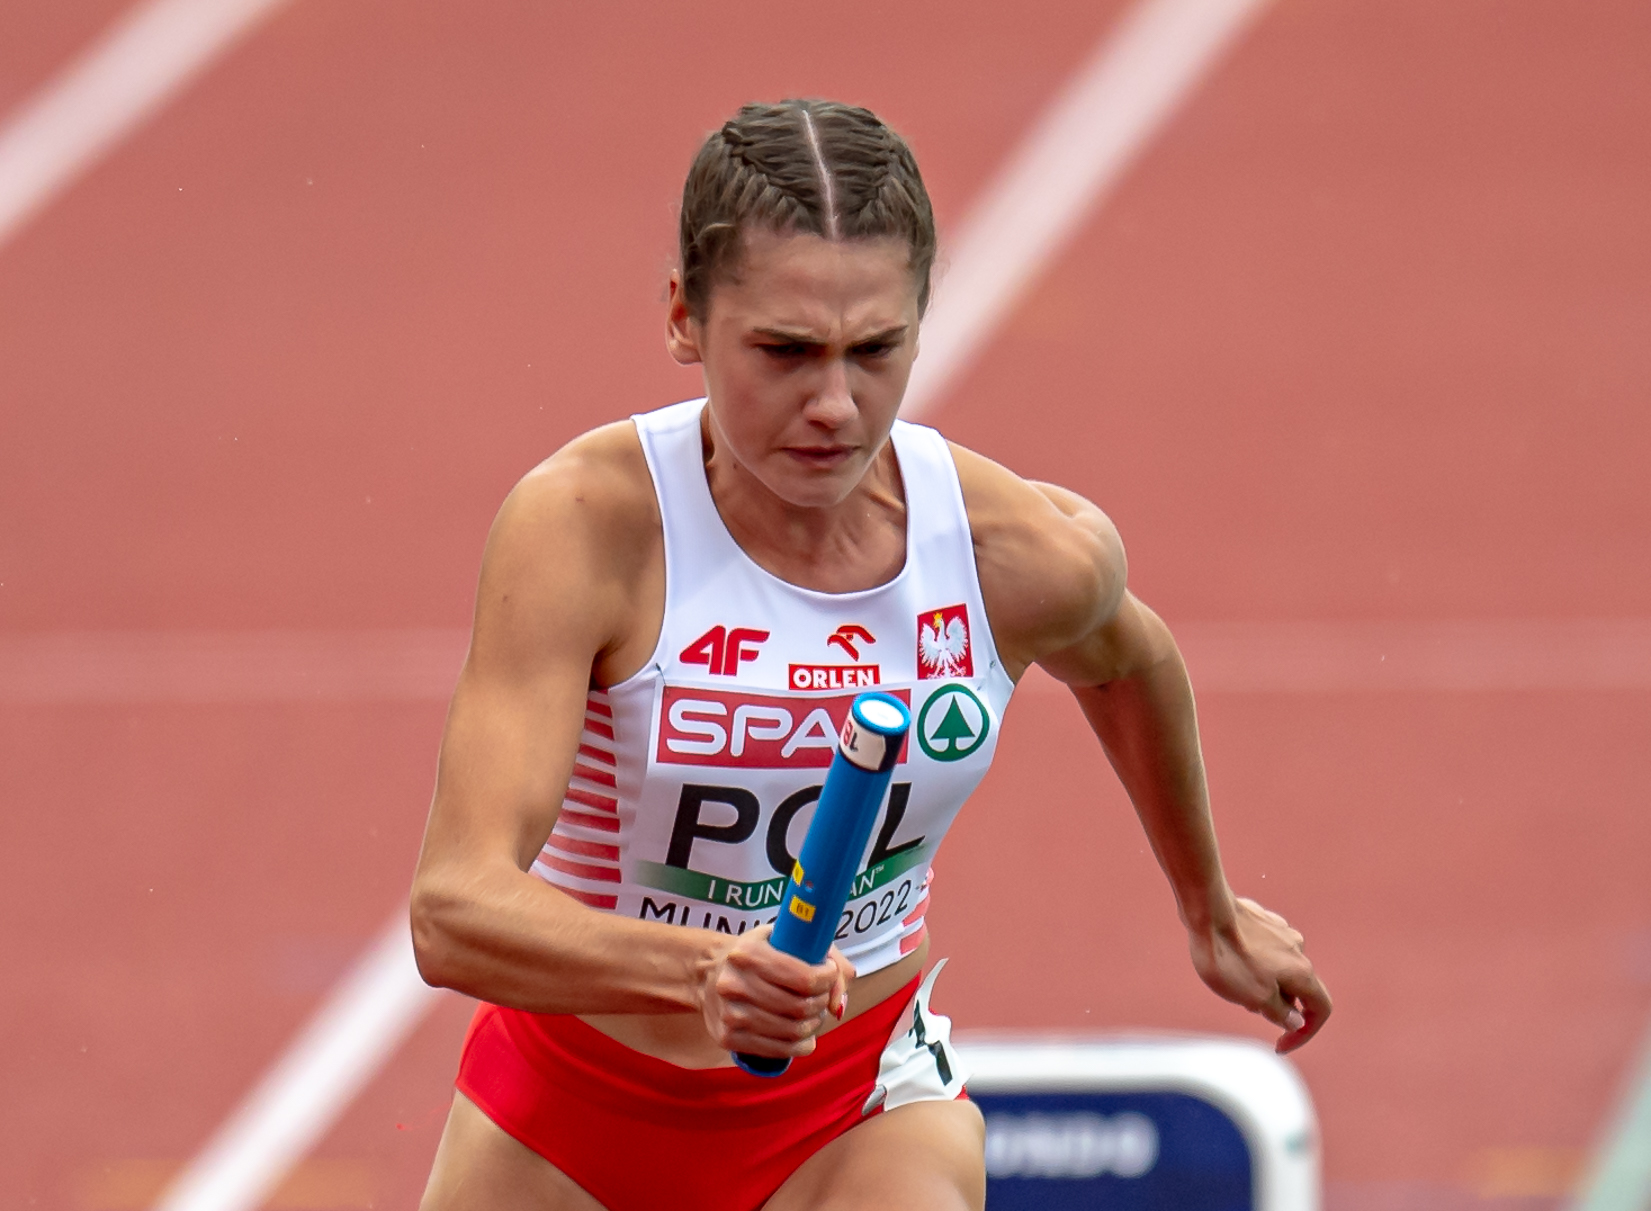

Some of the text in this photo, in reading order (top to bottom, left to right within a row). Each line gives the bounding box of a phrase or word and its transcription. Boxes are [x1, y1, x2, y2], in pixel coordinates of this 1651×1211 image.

[679, 624, 771, 677] 4F
[792, 667, 876, 689] ORLEN
[666, 698, 840, 760] SPA
[708, 879, 784, 908] I RUN
[834, 879, 912, 940] 2022
